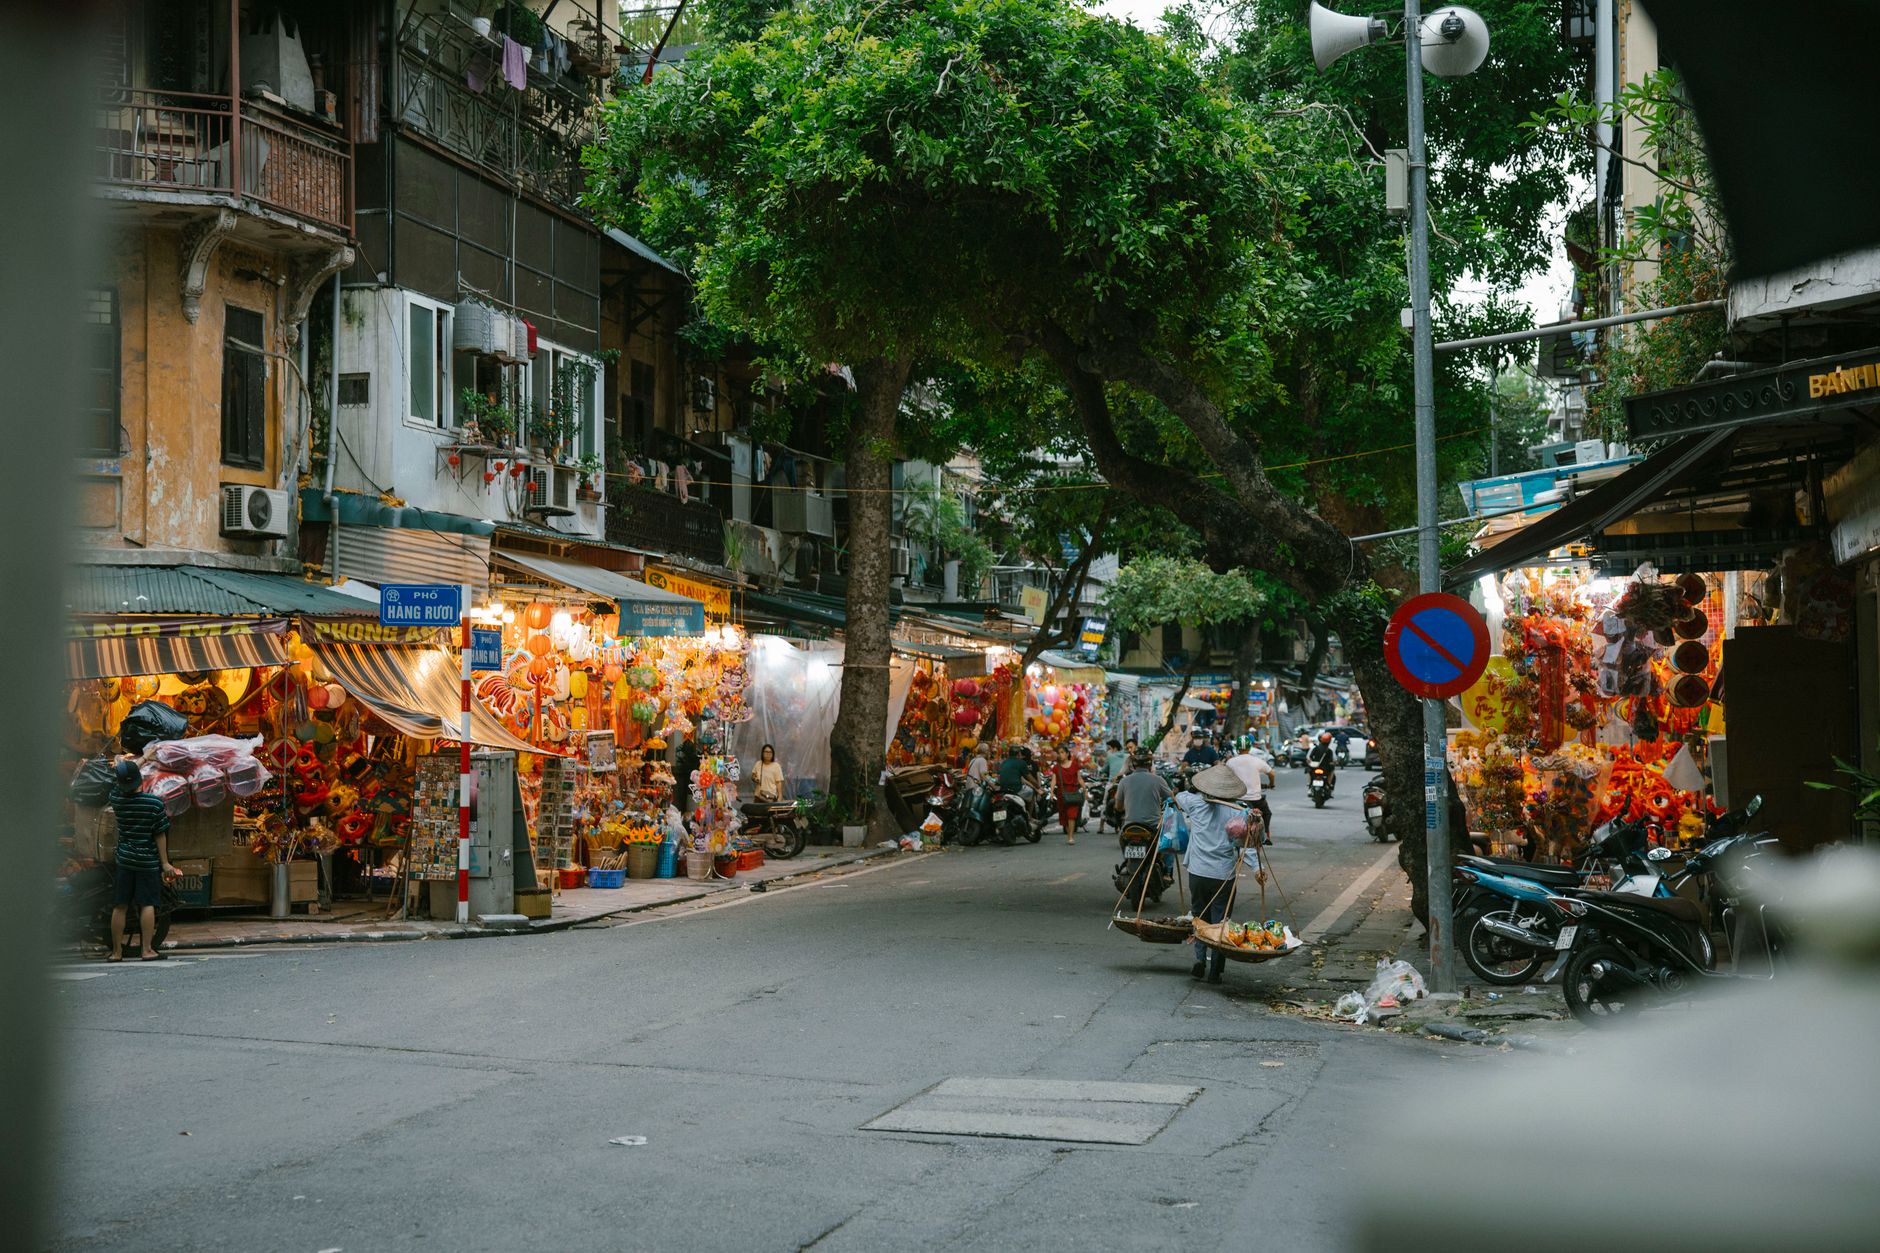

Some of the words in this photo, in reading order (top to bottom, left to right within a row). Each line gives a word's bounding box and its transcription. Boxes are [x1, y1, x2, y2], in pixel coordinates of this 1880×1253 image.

[651, 575, 667, 588] 54
[413, 588, 438, 600] PHỐ
[387, 602, 421, 620] HÀNG
[425, 604, 454, 620] RƯƠI
